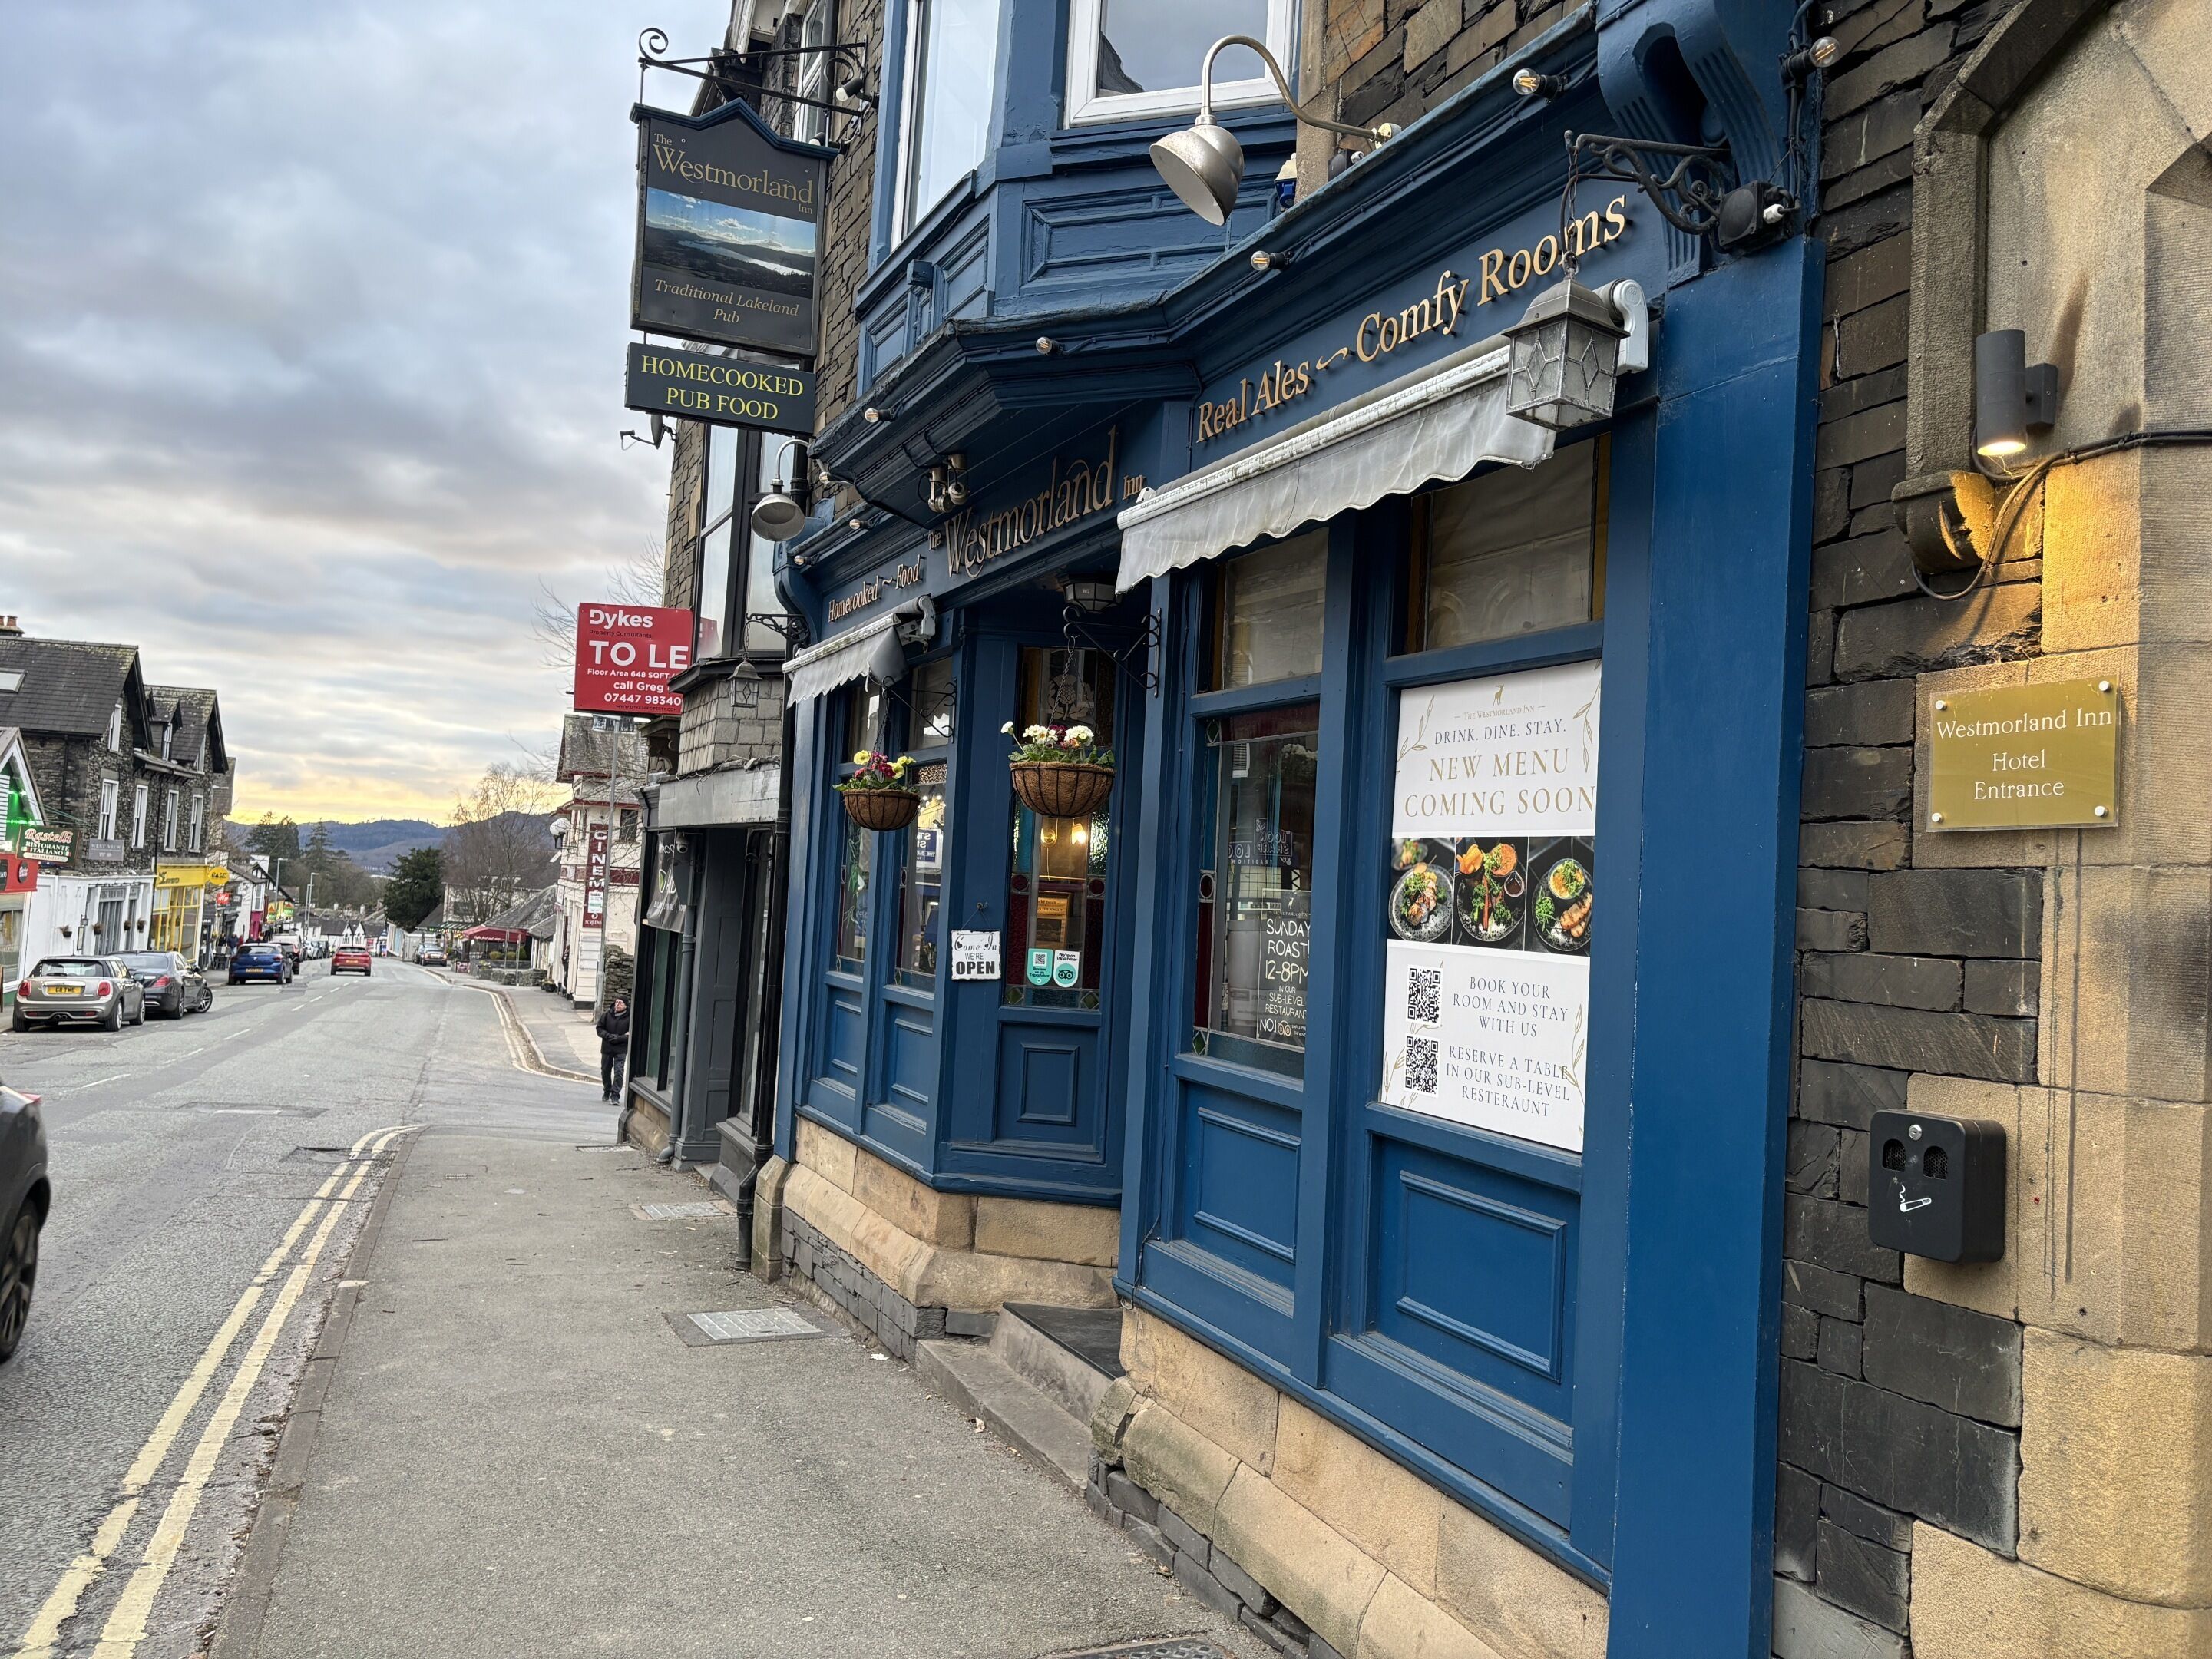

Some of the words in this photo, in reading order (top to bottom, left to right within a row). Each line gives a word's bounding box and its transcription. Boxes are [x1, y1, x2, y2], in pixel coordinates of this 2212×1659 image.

[654, 133, 673, 146] The
[653, 144, 814, 205] Westmorland
[799, 203, 813, 214] Inn
[655, 279, 735, 306] Traditional
[737, 295, 799, 317] Lakeland
[713, 309, 740, 324] Pub
[1196, 378, 1248, 443] Real
[1253, 359, 1309, 411] Ales
[1356, 270, 1468, 362] Comfy
[1477, 194, 1626, 306] Rooms
[641, 355, 804, 397] HOMECOOKED
[666, 387, 711, 410] PUB
[717, 395, 779, 421] FOOD
[927, 530, 941, 552] The
[944, 425, 1118, 579] Westmorland
[1123, 474, 1144, 501] Inn
[828, 575, 879, 623] Homecooked
[895, 554, 921, 590] Food
[589, 609, 653, 630] Dykes
[589, 640, 636, 666] TO
[649, 644, 689, 669] LE
[613, 681, 633, 690] call
[636, 682, 664, 693] Greg
[604, 693, 642, 703] 07447
[645, 696, 682, 706] 98340
[1434, 728, 1479, 745] DRINK.
[1484, 724, 1519, 740] DINE.
[1526, 719, 1566, 735] STAY.
[1937, 709, 2067, 739] Westmorland
[2075, 708, 2112, 728] Inn
[1429, 755, 1482, 782] NEW
[1492, 748, 1569, 777] MENU
[1992, 749, 2045, 772] Hotel
[1404, 791, 1506, 818] COMING
[1517, 785, 1595, 815] SOON
[1974, 781, 2065, 800] Entrance
[25, 841, 70, 851] RISTORANTE
[30, 847, 64, 855] ITALIANO
[589, 830, 607, 892] CINEM
[1266, 918, 1311, 937] SUNDAY
[954, 934, 980, 951] Come
[984, 934, 997, 951] In
[1268, 940, 1310, 960] ROAST!
[956, 961, 995, 975] OPEN
[1269, 992, 1306, 1007] SUB-LEVEL
[1285, 985, 1296, 993] OUR
[1470, 977, 1506, 994] BOOK
[1512, 982, 1551, 1000] YOUR
[1453, 993, 1492, 1011] ROOM
[1497, 1000, 1527, 1016] AND
[1532, 1004, 1569, 1022] STAY
[1479, 1016, 1515, 1034] WITH
[1521, 1023, 1537, 1037] US
[1449, 1046, 1505, 1068] RESERVE
[1509, 1057, 1519, 1070] A
[1525, 1059, 1569, 1080] TABLE
[1447, 1063, 1460, 1076] IN
[1464, 1067, 1492, 1084] OUR
[1497, 1074, 1570, 1101] SUB-LEVEL
[1462, 1086, 1550, 1117] RESTERAUNT
